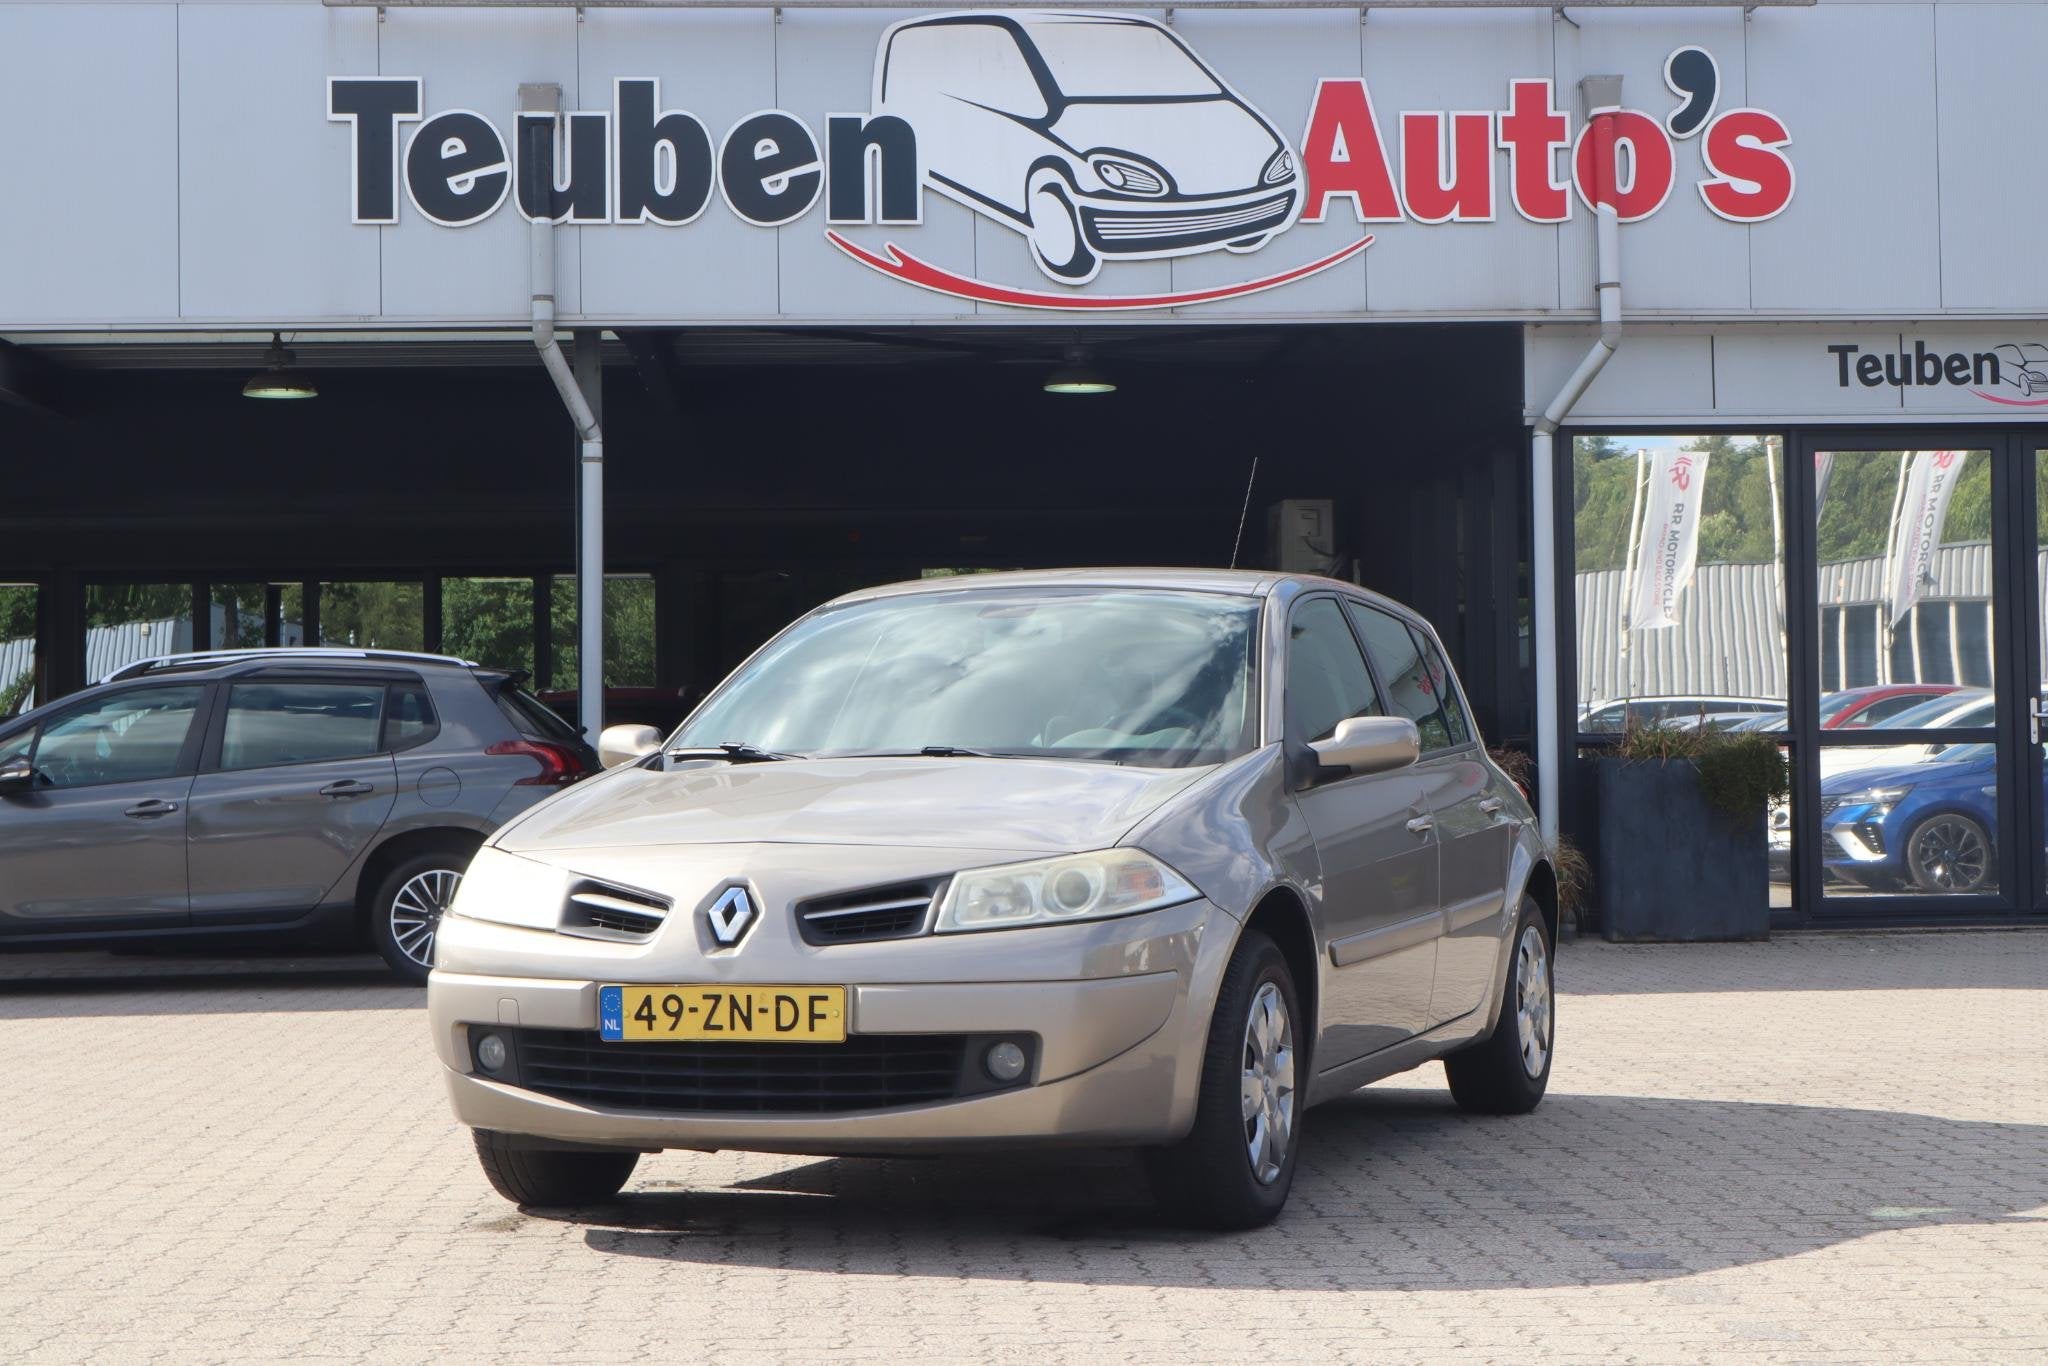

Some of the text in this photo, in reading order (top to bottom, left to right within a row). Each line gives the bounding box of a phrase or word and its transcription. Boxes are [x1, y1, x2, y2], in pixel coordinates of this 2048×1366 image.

[327, 45, 1796, 227] Teuben Auto's
[1827, 340, 2000, 388] Teuben
[1929, 472, 1946, 495] RR
[1671, 502, 1685, 525] RR
[604, 1019, 621, 1031] NL
[633, 993, 829, 1033] 49-ZN-DF
